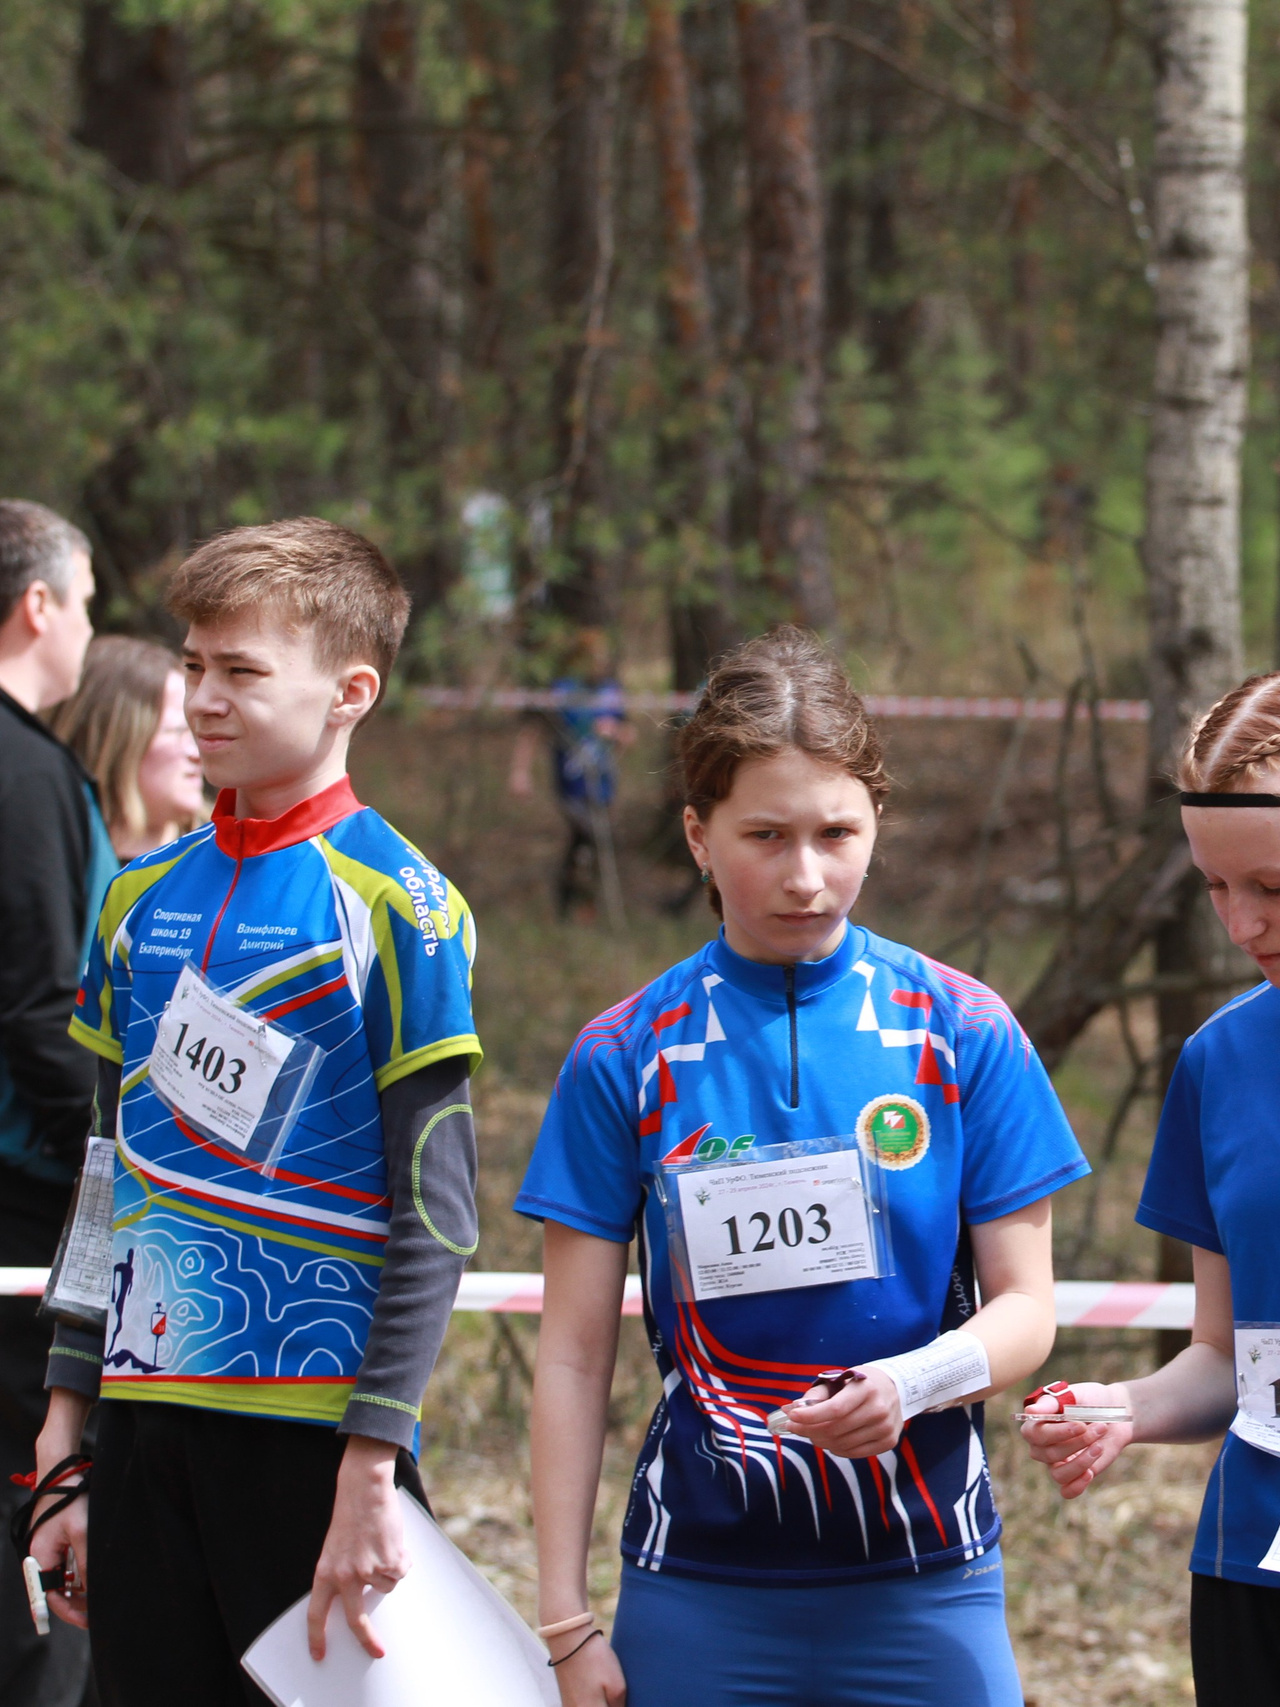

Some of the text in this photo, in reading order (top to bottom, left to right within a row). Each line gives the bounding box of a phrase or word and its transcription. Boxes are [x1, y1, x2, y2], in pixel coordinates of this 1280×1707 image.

[153, 908, 203, 923] Спортивная
[399, 866, 439, 957] область
[150, 927, 192, 939] школа 19
[236, 923, 299, 936] Ванифатьев
[139, 942, 194, 960] Екатеринбург
[239, 939, 285, 951] Дмитрий
[173, 1022, 246, 1094] 1403
[721, 1203, 832, 1256] 1203
